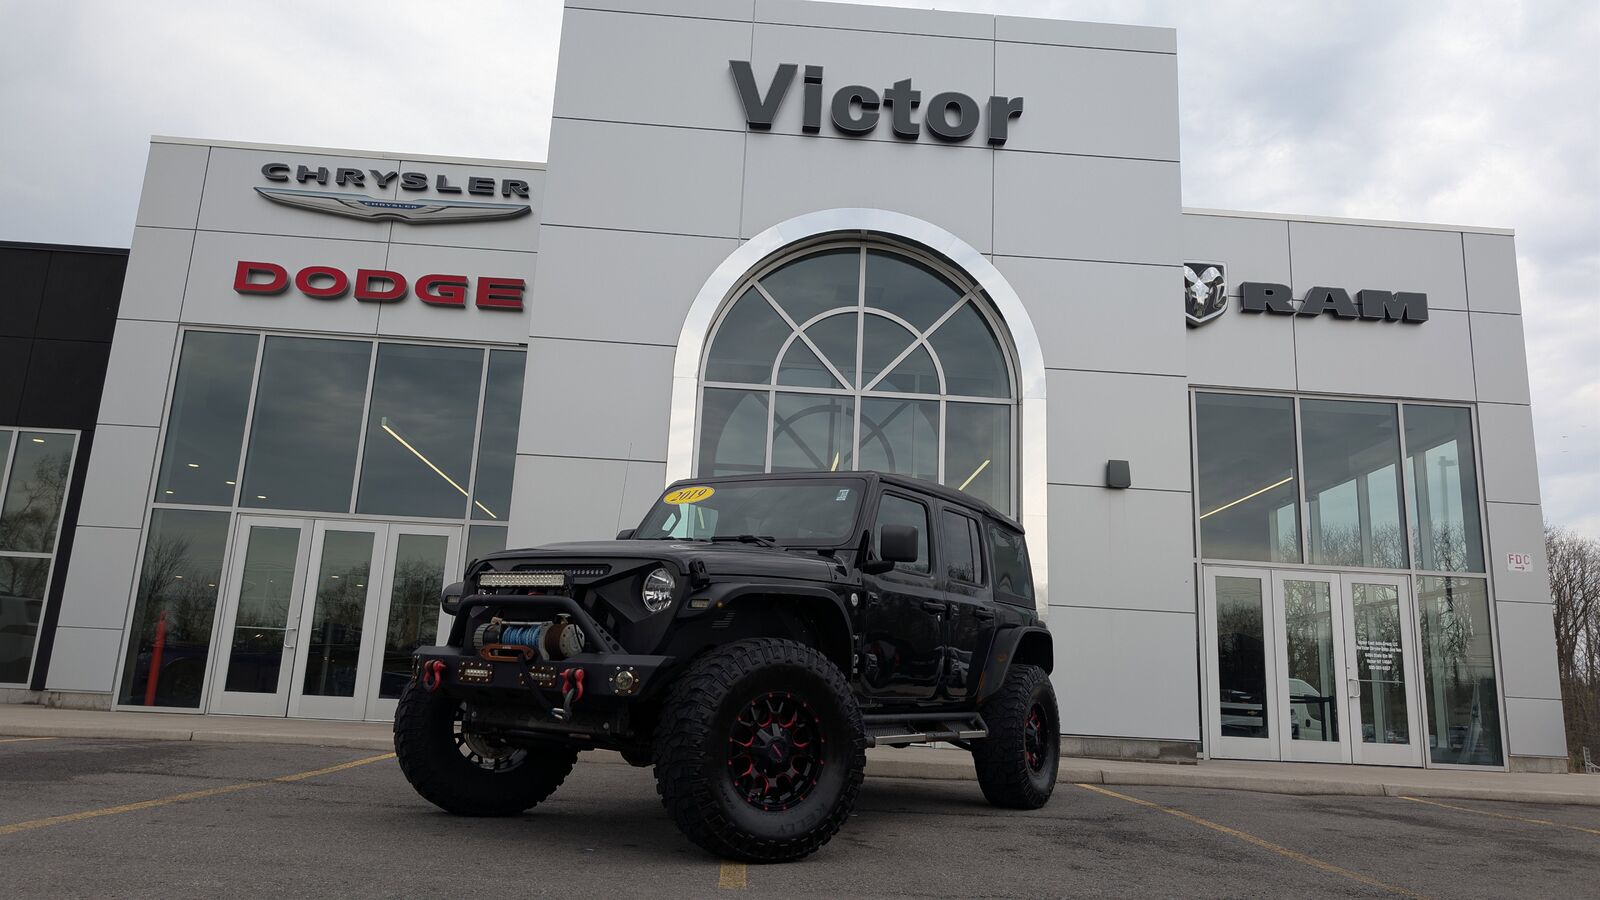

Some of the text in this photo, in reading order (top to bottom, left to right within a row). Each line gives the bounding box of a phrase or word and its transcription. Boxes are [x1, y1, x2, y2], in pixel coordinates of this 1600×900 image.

[729, 60, 1024, 145] Victor
[261, 163, 530, 199] CHRYSLER
[233, 261, 526, 312] DODGE
[1239, 281, 1429, 323] RAM
[670, 488, 708, 502] 2019
[1508, 554, 1530, 565] FDC
